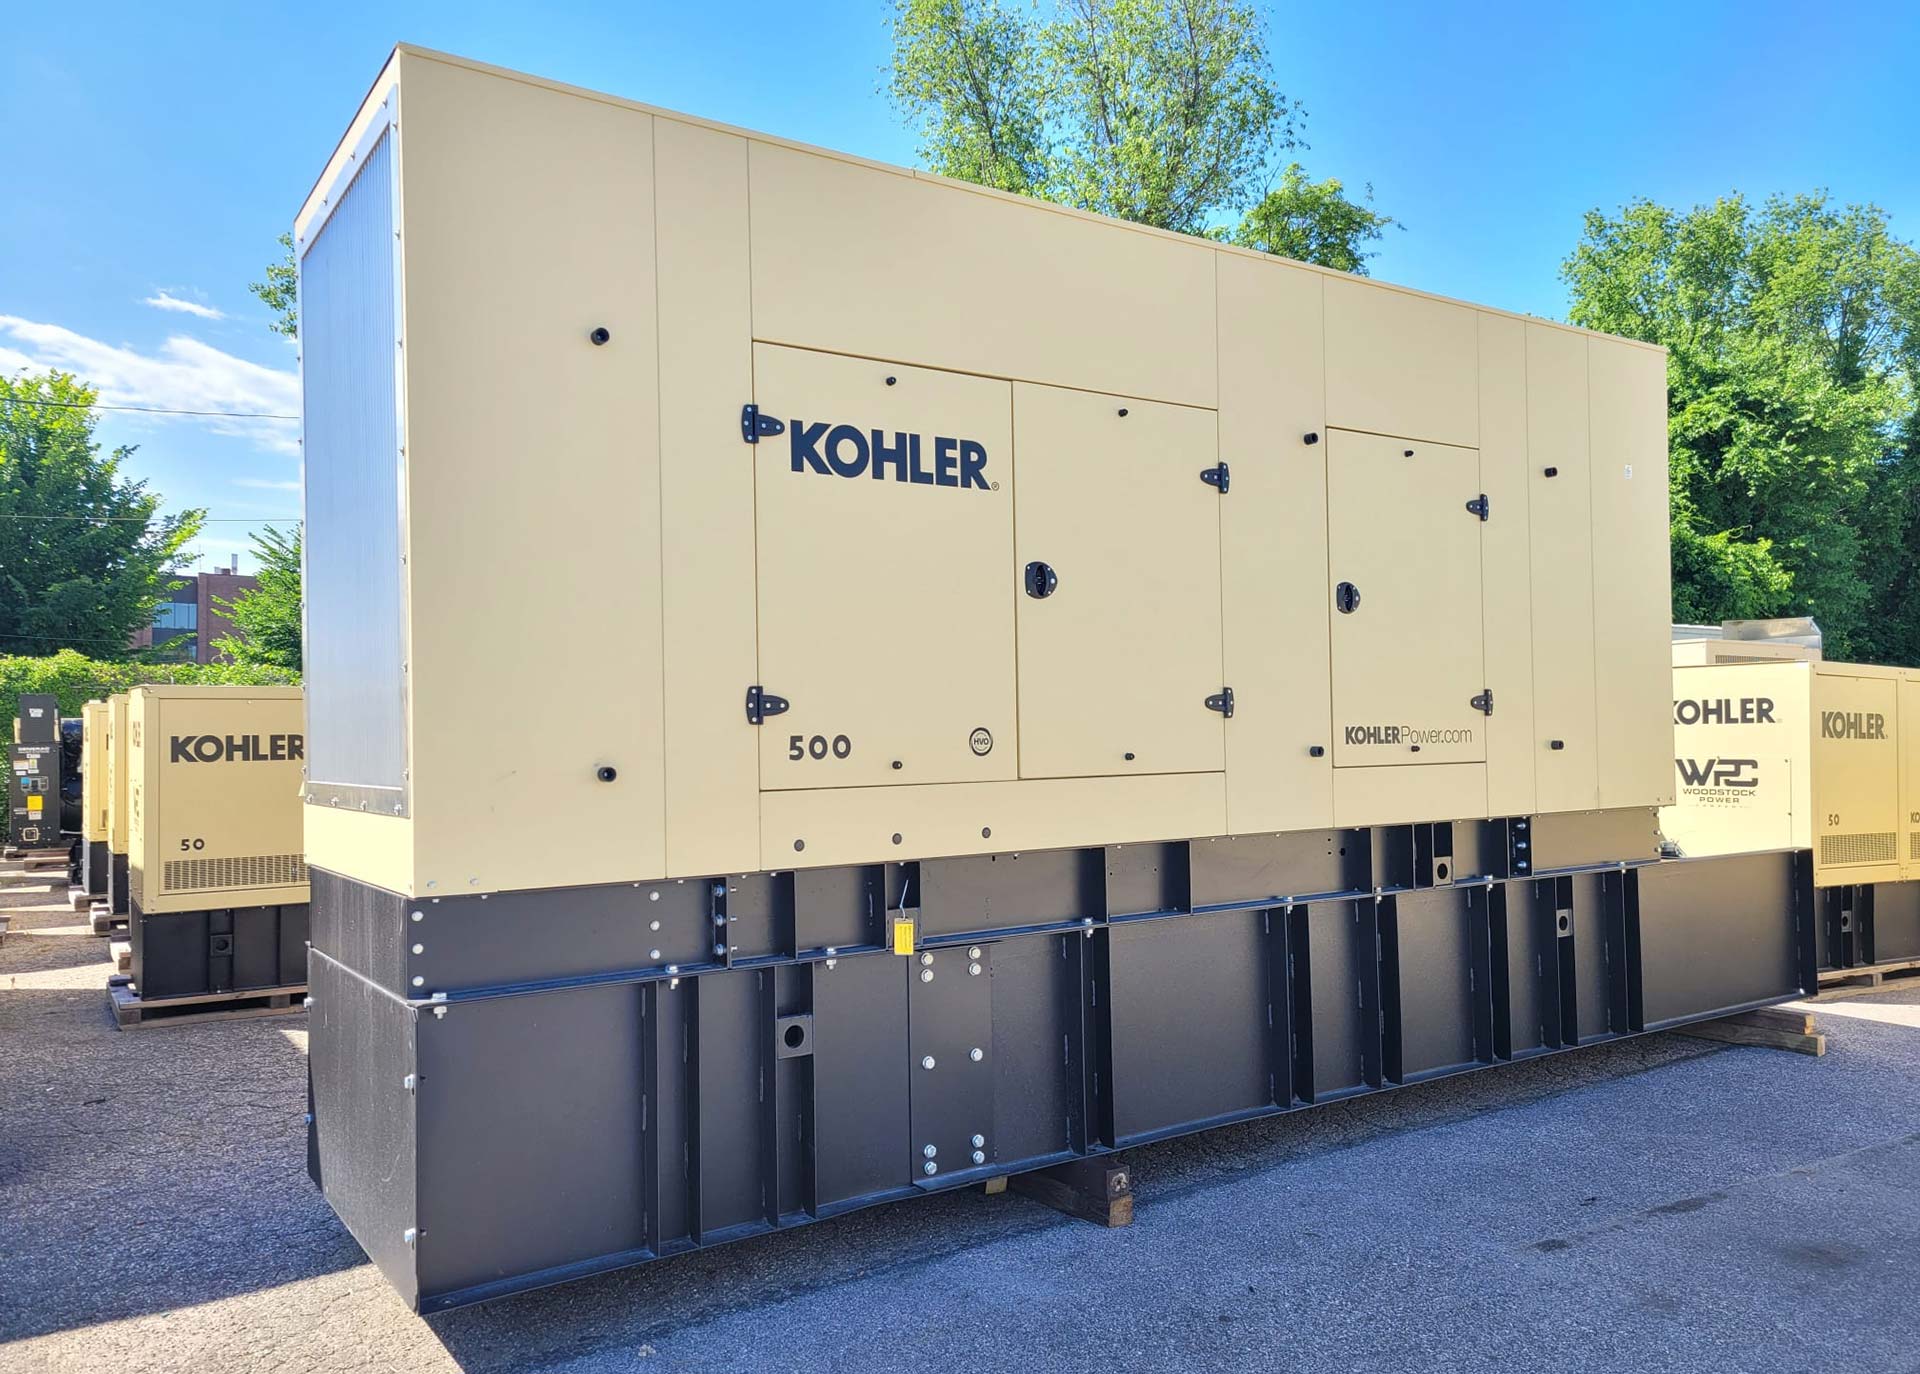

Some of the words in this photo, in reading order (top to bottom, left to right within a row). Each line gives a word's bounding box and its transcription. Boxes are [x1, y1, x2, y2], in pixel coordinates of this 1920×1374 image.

[790, 419, 991, 490] KOHLER
[1821, 711, 1885, 739] KOHLER
[1345, 726, 1472, 745] KOHLERPower.com
[170, 734, 304, 763] KOHLER
[789, 734, 852, 761] 500
[1682, 788, 1756, 797] WOODSTOCK
[1699, 796, 1740, 804] POWER
[1828, 814, 1840, 826] 50
[180, 838, 205, 851] 50
